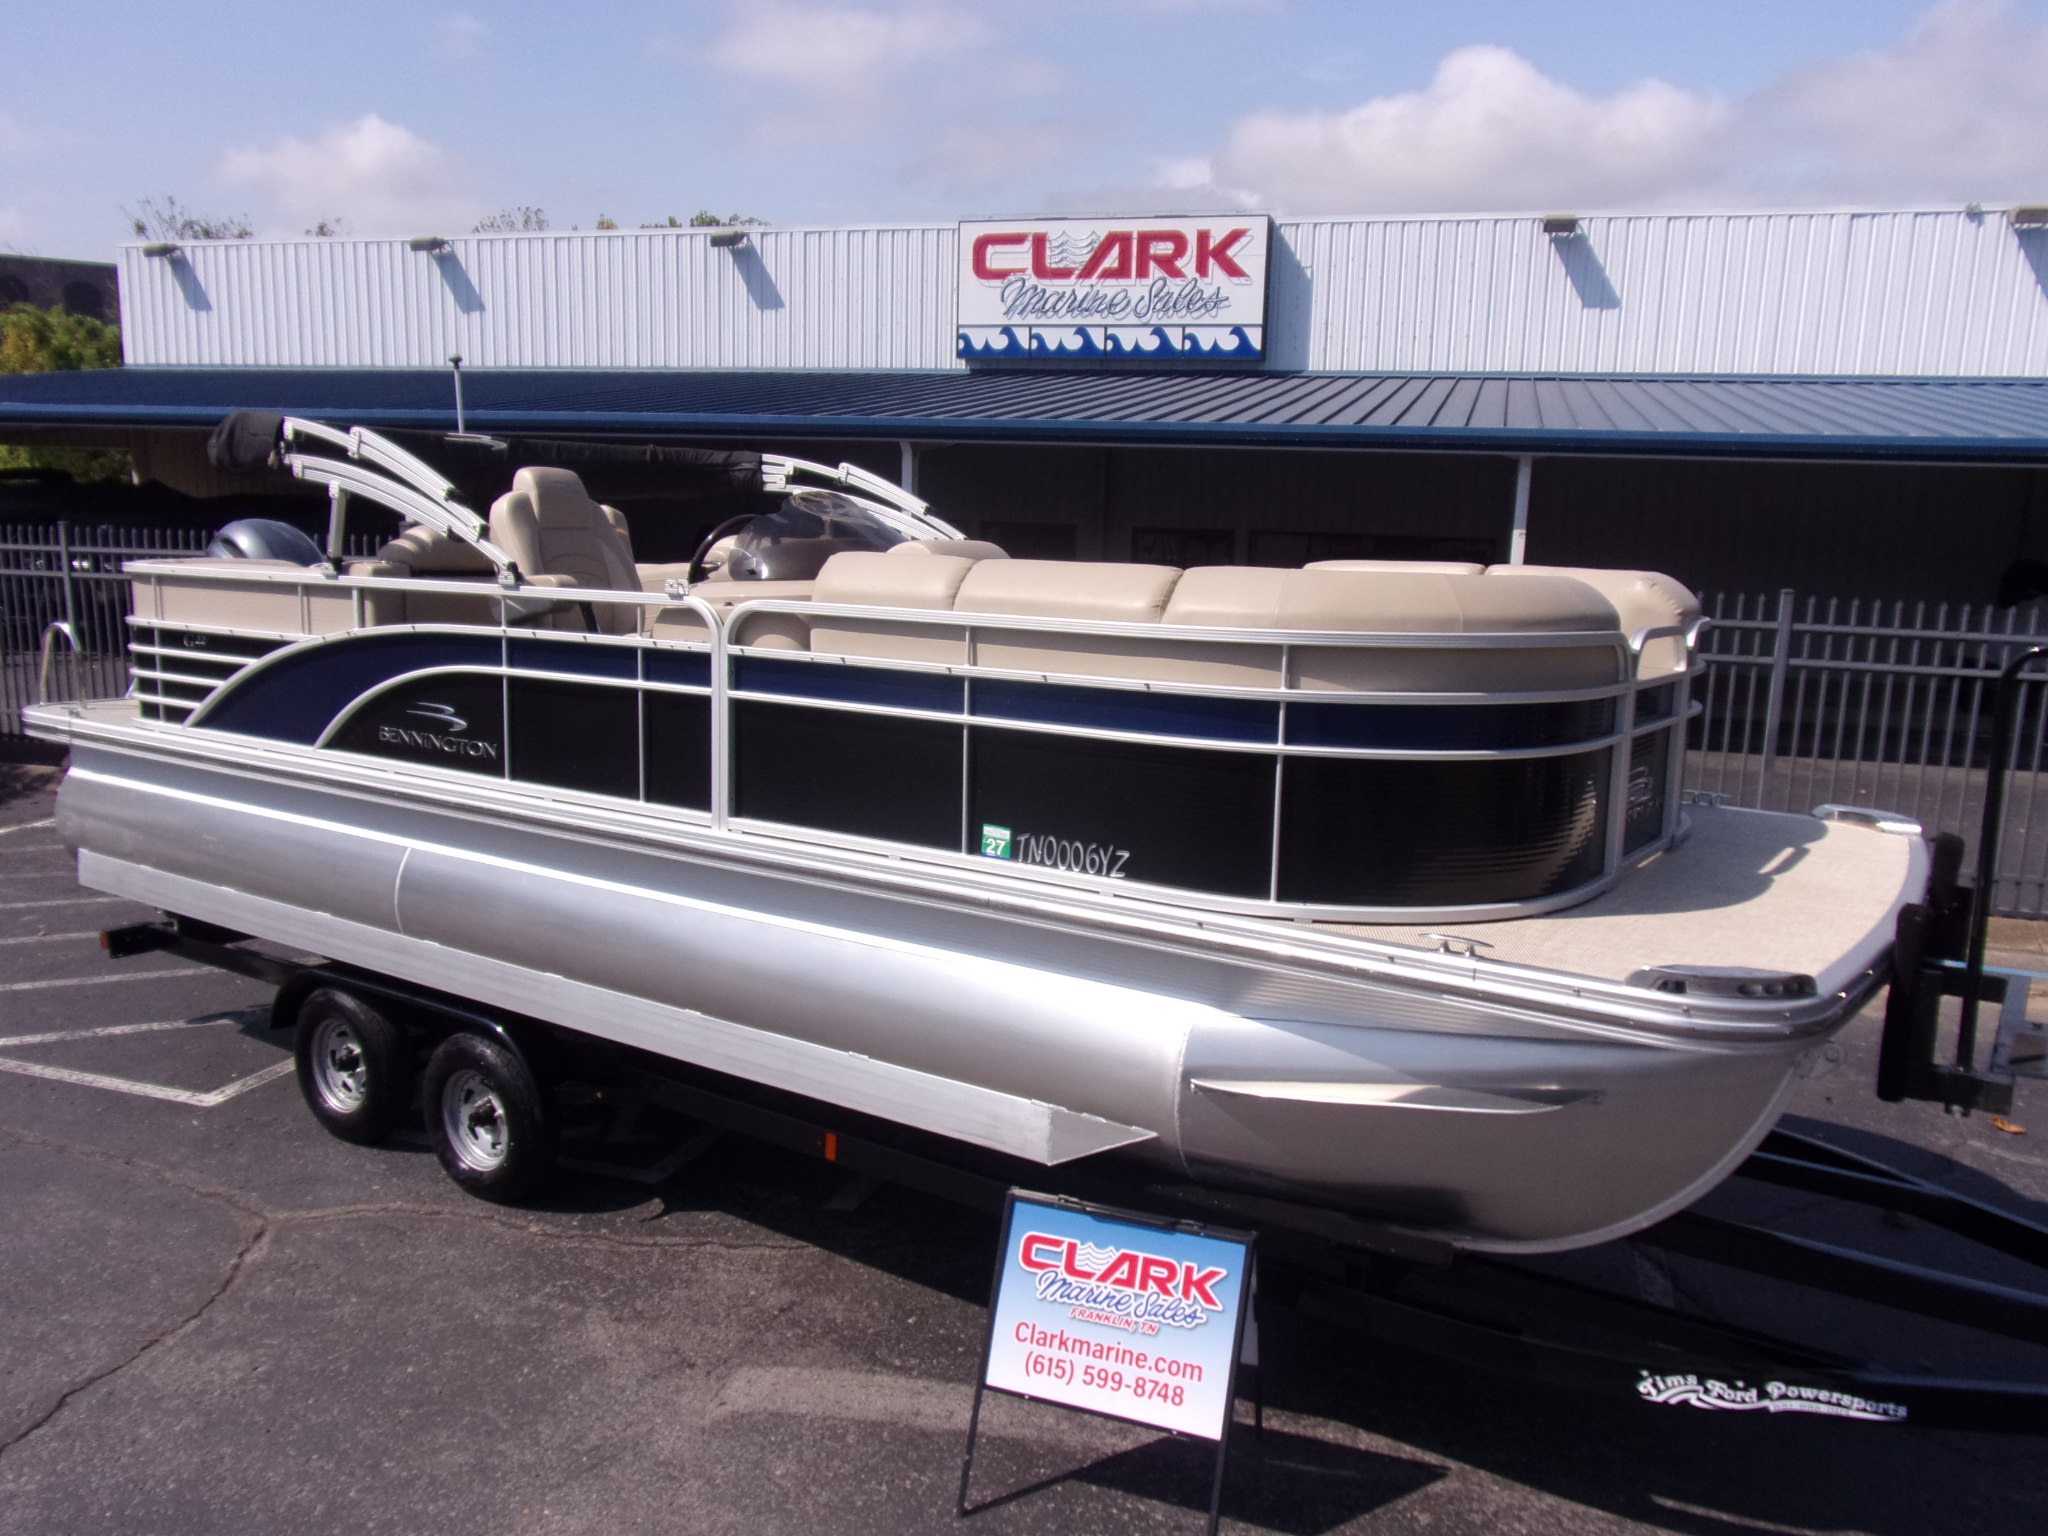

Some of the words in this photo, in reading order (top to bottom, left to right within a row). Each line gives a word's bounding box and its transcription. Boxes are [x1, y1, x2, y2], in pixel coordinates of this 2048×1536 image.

[972, 228, 1253, 281] CLARK
[1000, 277, 1130, 318] Marine
[1133, 276, 1230, 320] Sales
[378, 725, 497, 759] BENNINGTON
[986, 837, 1006, 856] 27
[1020, 1233, 1227, 1309] CLARK
[1037, 1269, 1133, 1313] Marine
[1133, 1291, 1204, 1325] Sales
[1070, 1307, 1136, 1331] FRANKLIN,
[1139, 1321, 1158, 1335] TN
[1014, 1321, 1203, 1382] Clarkmarine.com
[1025, 1350, 1075, 1386] (615)
[1082, 1364, 1185, 1407] 599-8748
[1704, 1379, 1758, 1403] Ford
[1765, 1381, 1908, 1418] Powersports
